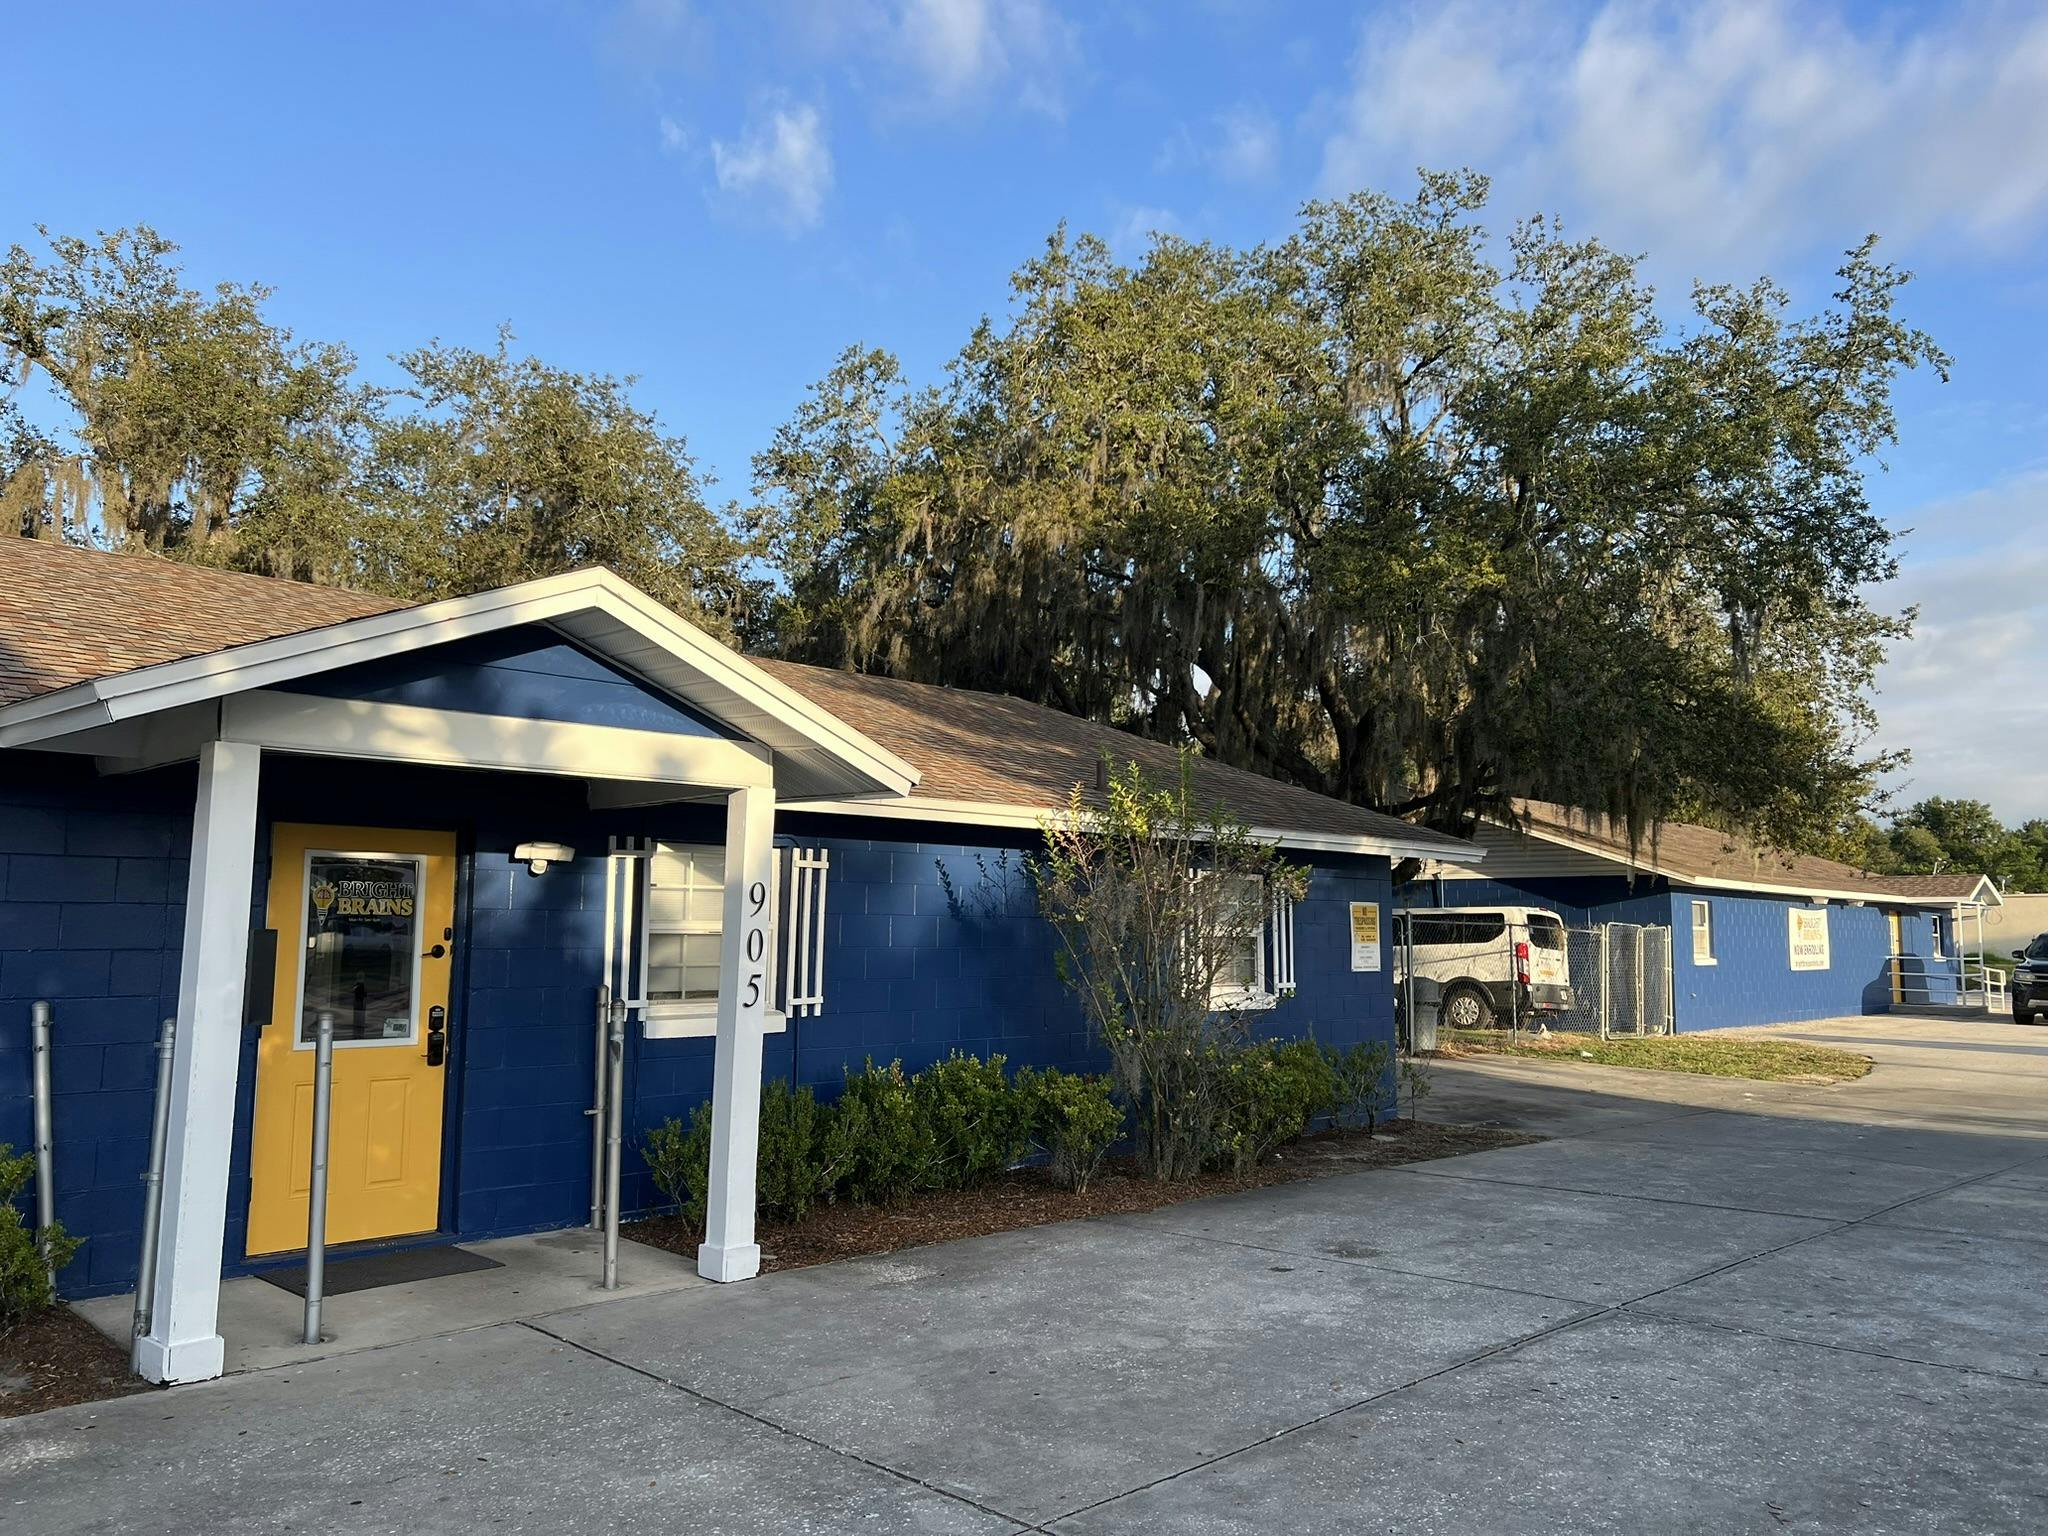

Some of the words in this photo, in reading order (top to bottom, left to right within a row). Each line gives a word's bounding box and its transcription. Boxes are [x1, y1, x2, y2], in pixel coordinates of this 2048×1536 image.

[338, 880, 415, 899] BRIGHT
[336, 898, 413, 916] BRAINS
[742, 881, 766, 1008] 905
